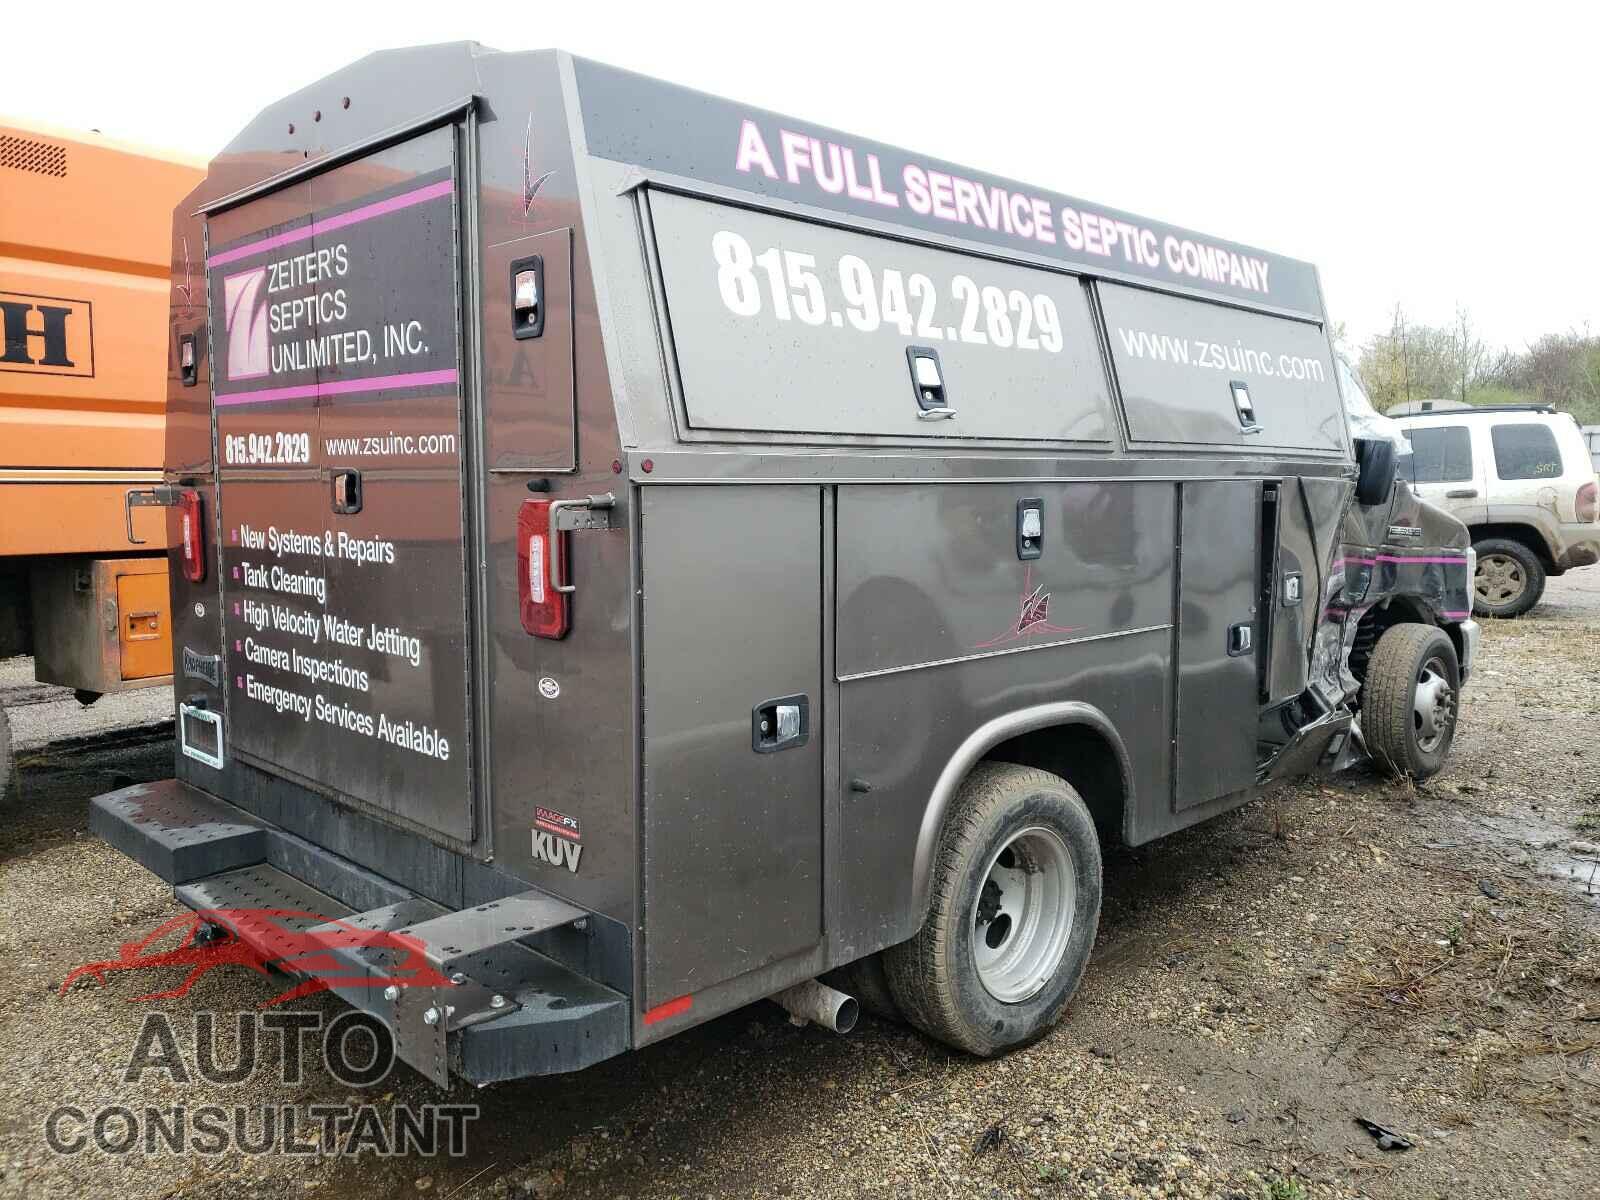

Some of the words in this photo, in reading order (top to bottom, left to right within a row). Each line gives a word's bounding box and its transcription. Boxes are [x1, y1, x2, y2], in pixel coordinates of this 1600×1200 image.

[736, 119, 779, 179] A
[780, 128, 899, 208] FULL
[902, 164, 1056, 244] SERVICE
[1061, 206, 1160, 268] SEPTIC
[1163, 235, 1270, 293] COMPANY
[267, 243, 349, 293] ZEITER'S
[711, 230, 1064, 354] 815.942.2829
[269, 289, 348, 333] SEPTICS
[271, 329, 377, 374] UNLIMITED,
[383, 320, 429, 358] INC.
[1118, 327, 1326, 383] www.zsuinc.com
[225, 431, 310, 465] 815.942.2829
[325, 430, 456, 456] www.zsuinc.com
[240, 524, 265, 550] New
[268, 526, 322, 558] Systems
[324, 530, 336, 557] &
[337, 531, 395, 567] Repairs
[241, 561, 269, 590] Tank
[271, 565, 326, 604] Cleaning
[243, 599, 269, 632] High
[271, 604, 321, 644] Velocity
[323, 613, 364, 648] Water
[367, 623, 421, 668] Jetting
[244, 637, 290, 671] Camera
[292, 648, 369, 693] Inspections
[246, 674, 312, 722] Emergency
[315, 694, 374, 737] Services
[377, 713, 450, 761] Available
[531, 828, 583, 873] KUV
